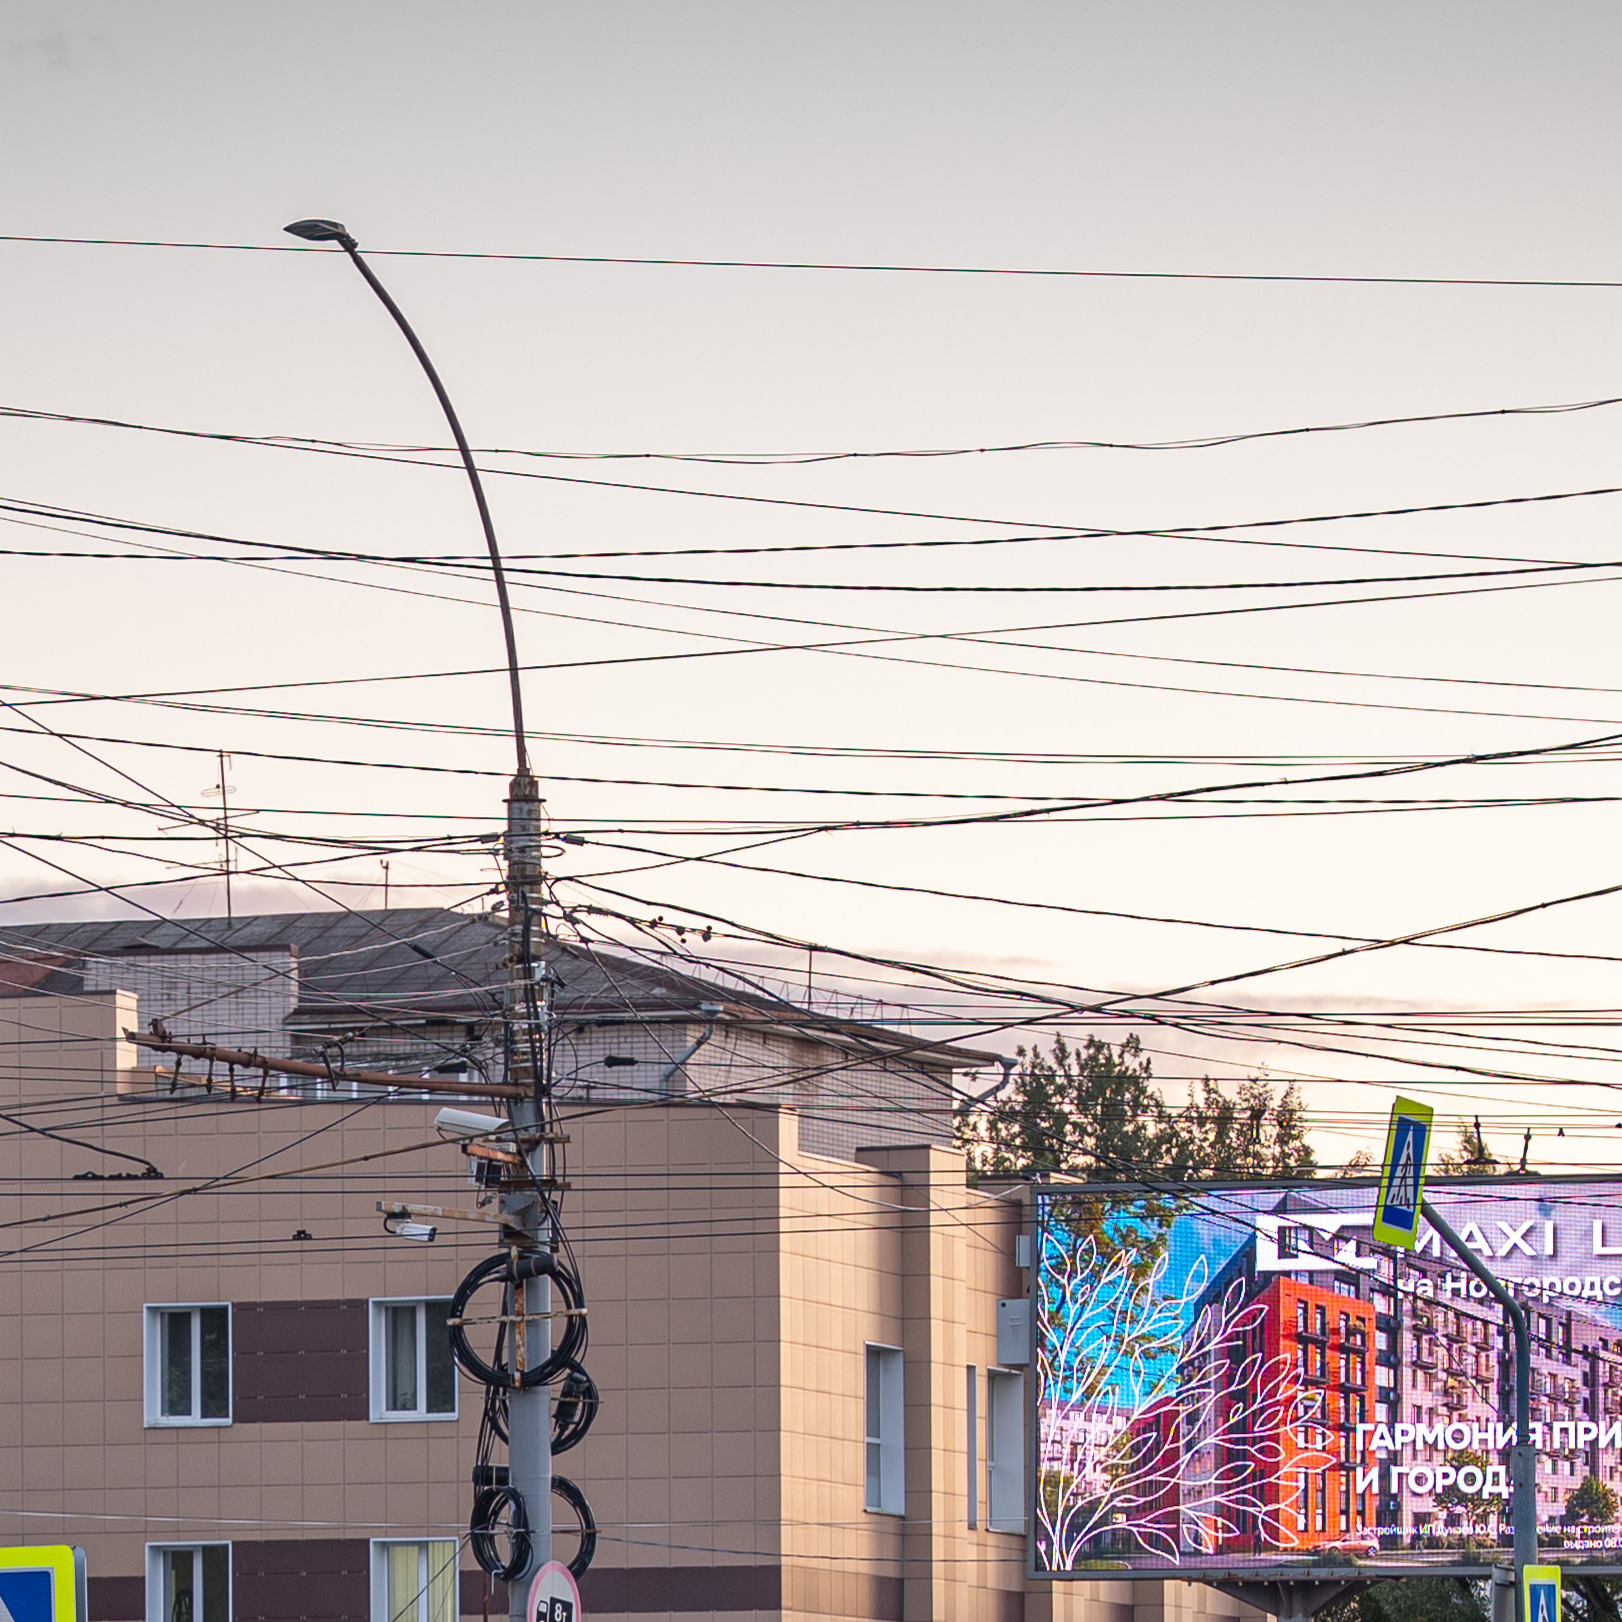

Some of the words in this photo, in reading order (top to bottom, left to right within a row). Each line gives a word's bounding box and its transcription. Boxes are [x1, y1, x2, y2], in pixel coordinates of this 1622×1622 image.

[1397, 1277, 1434, 1299] на
[1355, 1421, 1543, 1451] ГАРМОНИЯ
[1355, 1465, 1379, 1495] И
[1390, 1463, 1515, 1499] ГОРОД
